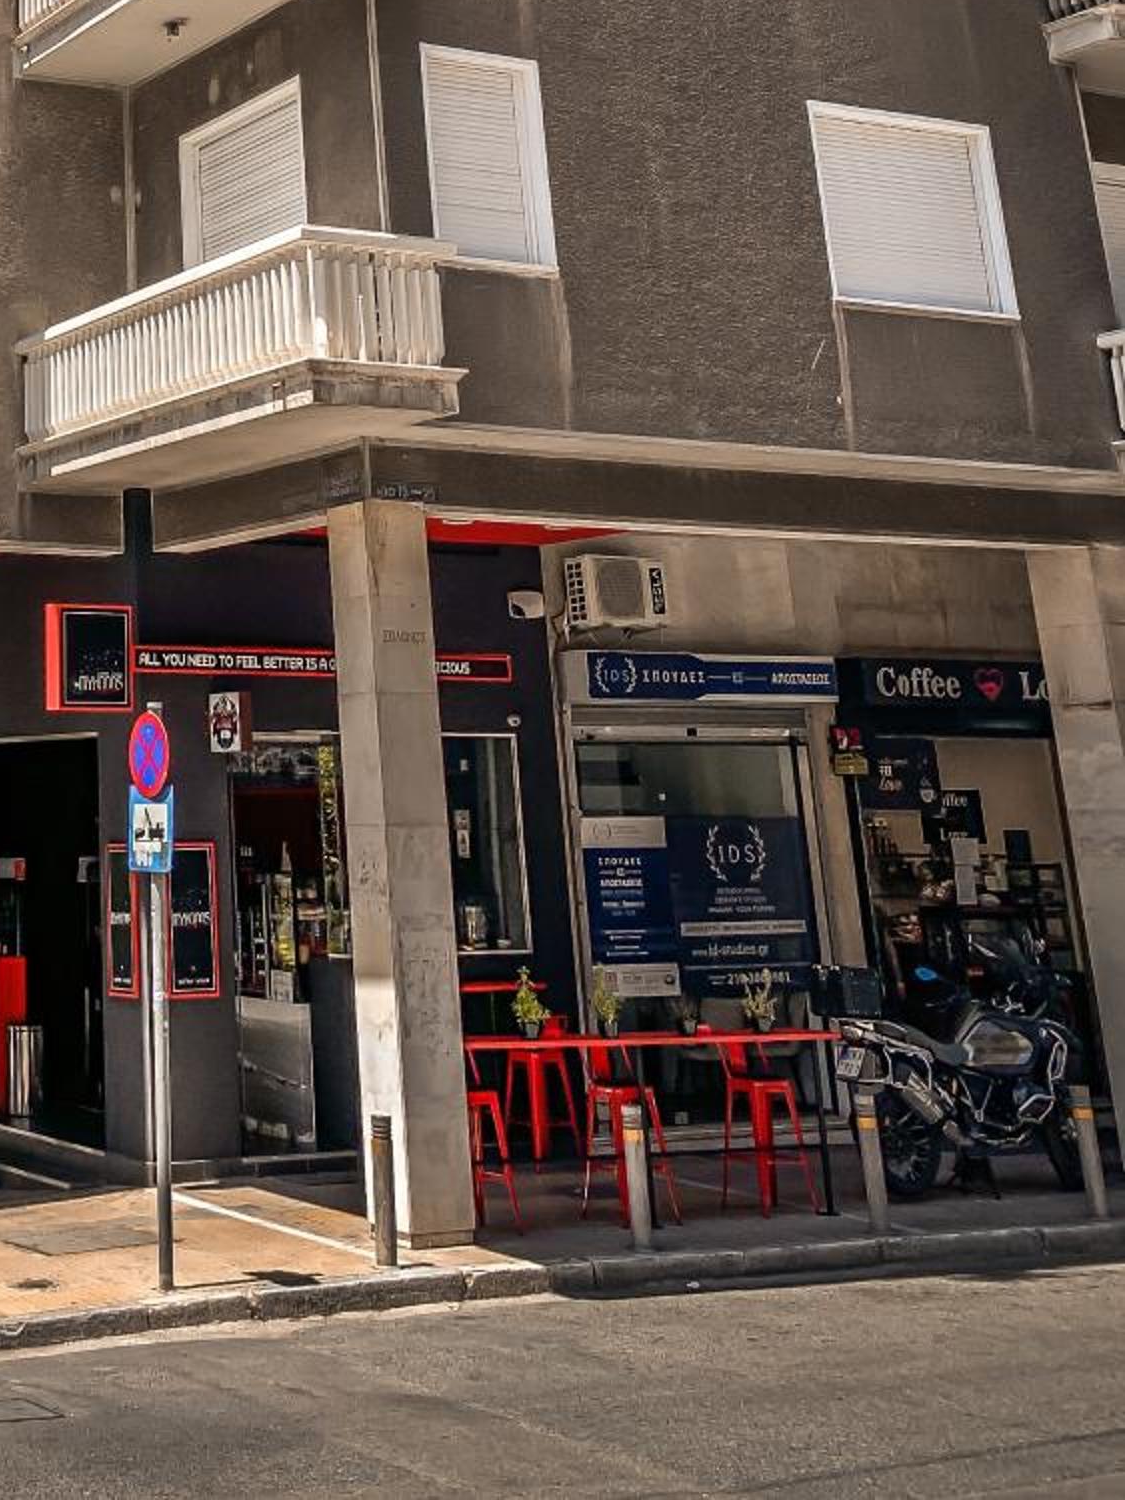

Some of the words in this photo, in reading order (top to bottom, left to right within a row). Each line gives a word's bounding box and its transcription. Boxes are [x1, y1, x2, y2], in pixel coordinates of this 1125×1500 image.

[139, 652, 161, 666] ALL
[162, 653, 186, 666] YOU
[187, 653, 218, 668] NEED
[219, 655, 234, 668] TO
[236, 655, 262, 669] FEEL
[263, 656, 304, 670] BETTER
[305, 657, 318, 671] IS
[318, 657, 328, 670] A
[642, 669, 706, 683] ΣΠΟΥΔΕΣ
[876, 667, 963, 698] Coffee
